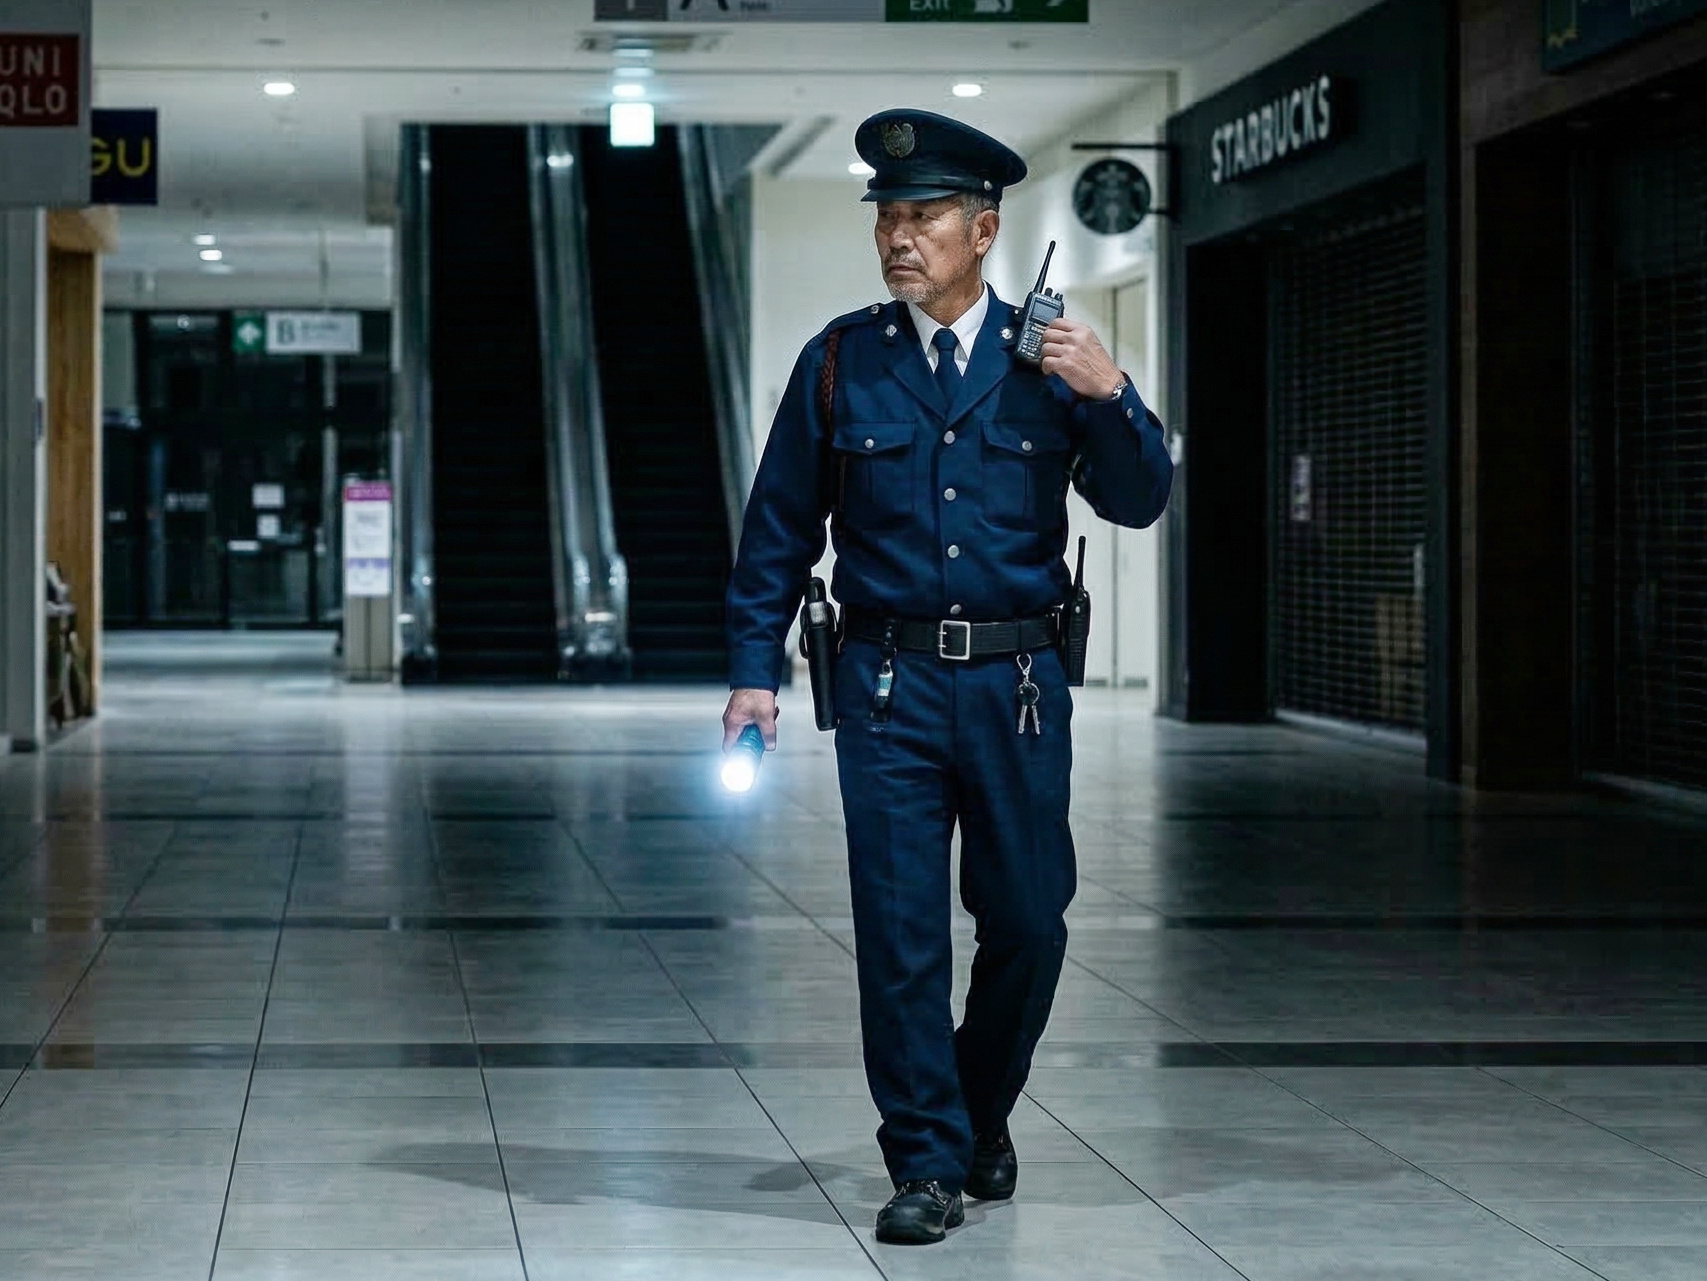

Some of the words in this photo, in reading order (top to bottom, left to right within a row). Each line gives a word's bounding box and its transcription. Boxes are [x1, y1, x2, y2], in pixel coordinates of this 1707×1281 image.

[0, 44, 61, 77] UNI
[0, 84, 68, 118] QLO
[1211, 74, 1331, 184] STARBUCKS
